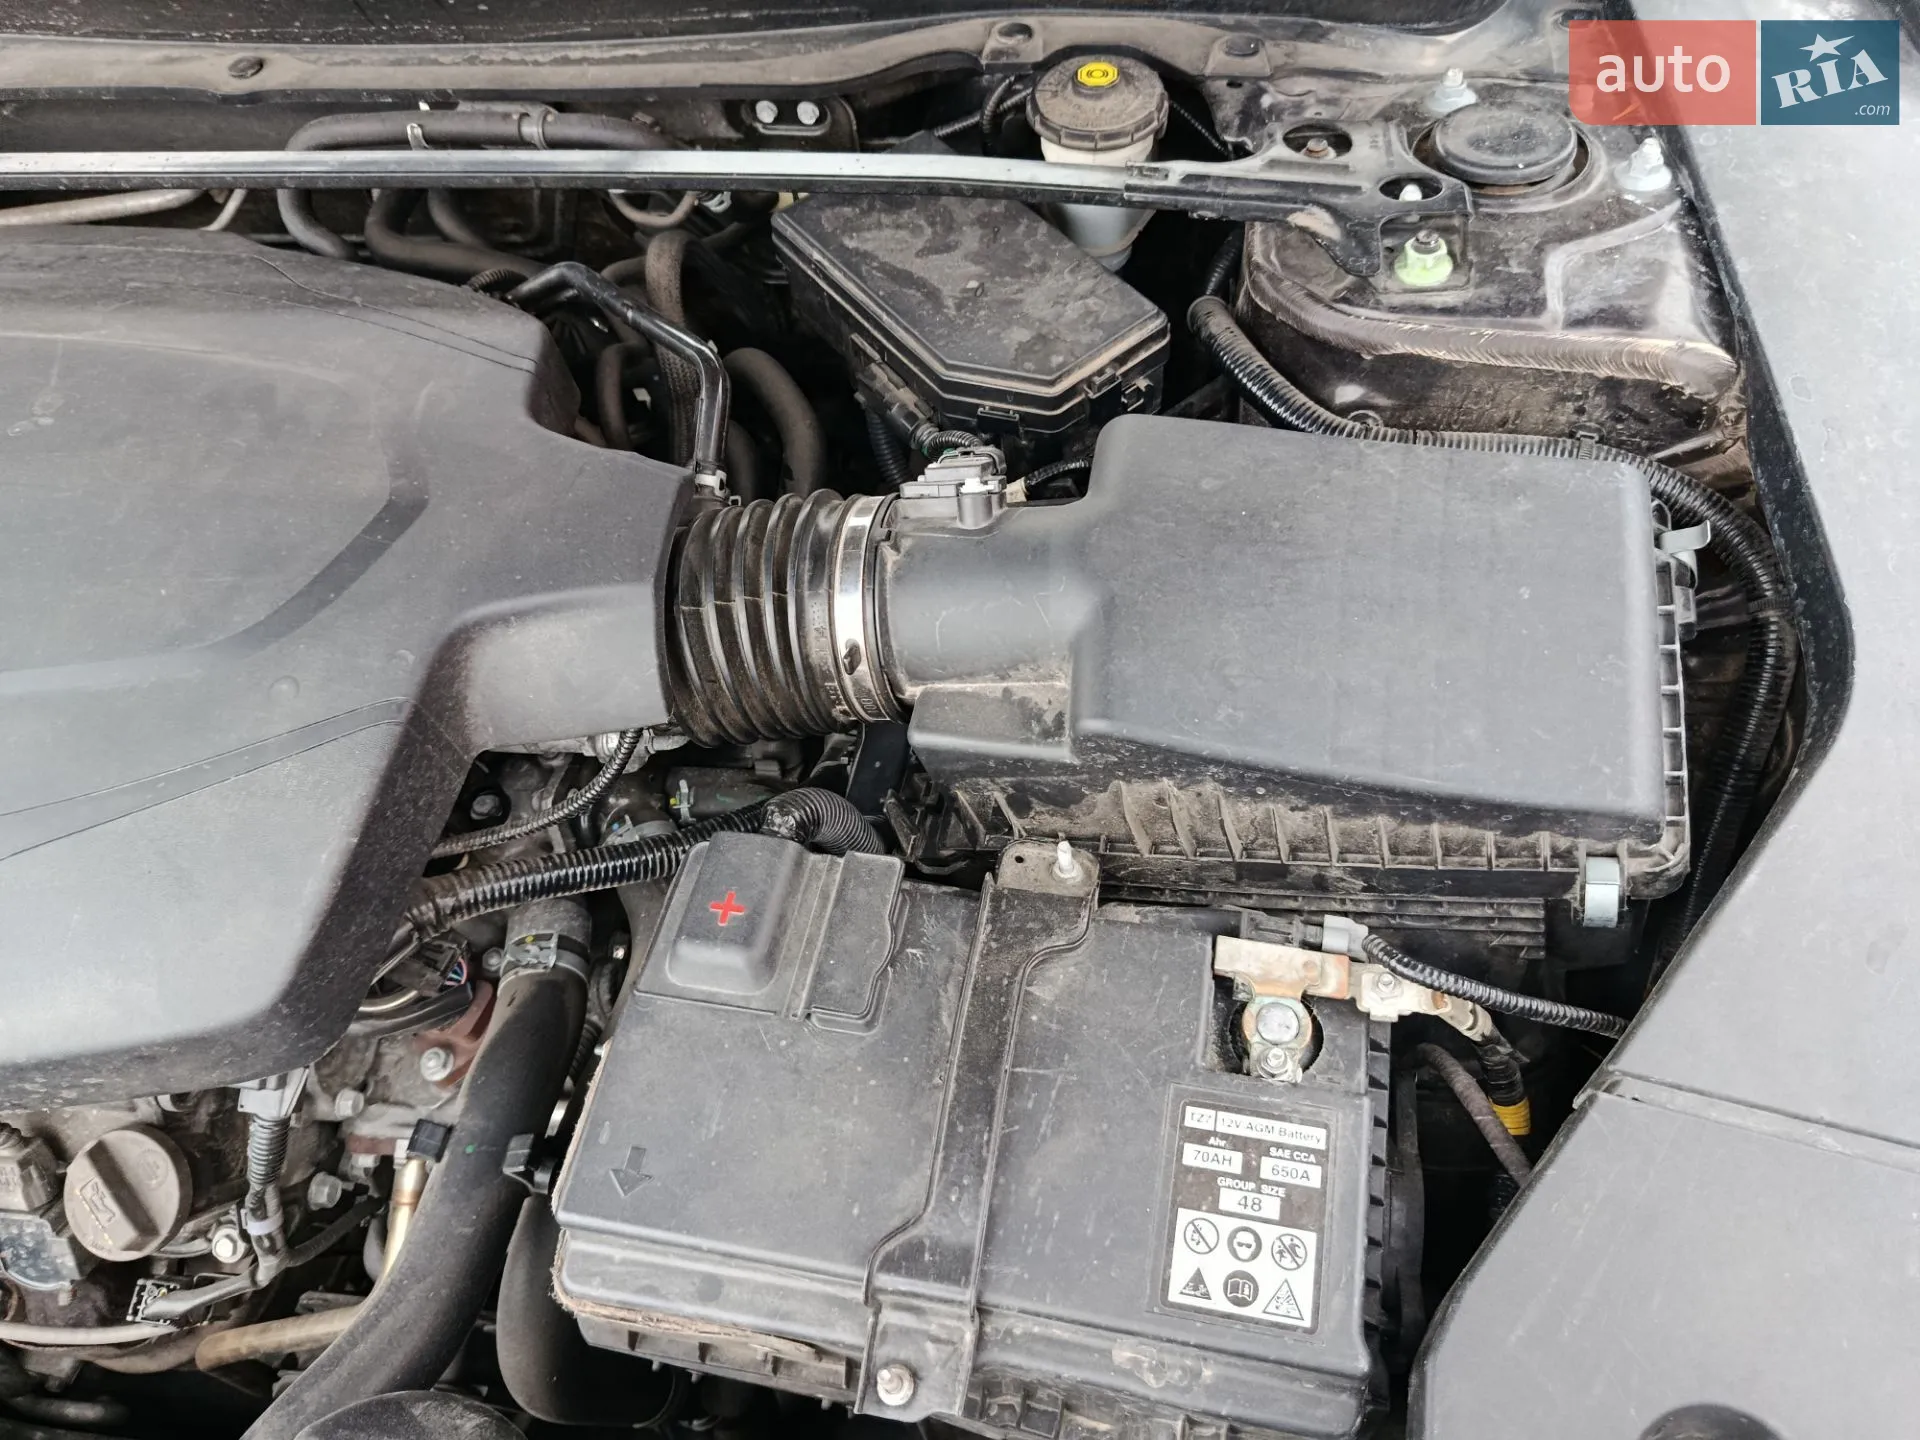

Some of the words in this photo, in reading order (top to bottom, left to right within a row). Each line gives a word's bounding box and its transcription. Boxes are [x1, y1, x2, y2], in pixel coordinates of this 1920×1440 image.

[1221, 1117, 1242, 1129] 12V
[1246, 1121, 1275, 1135] AGM
[1278, 1126, 1321, 1145] Battery
[1193, 1149, 1233, 1167] 70AH
[1269, 1146, 1292, 1159] SAE
[1293, 1151, 1317, 1164] CCA
[1271, 1164, 1311, 1182] 650A
[1216, 1176, 1256, 1192] GROUP
[1260, 1184, 1286, 1198] SIZE
[1236, 1195, 1262, 1213] 48
